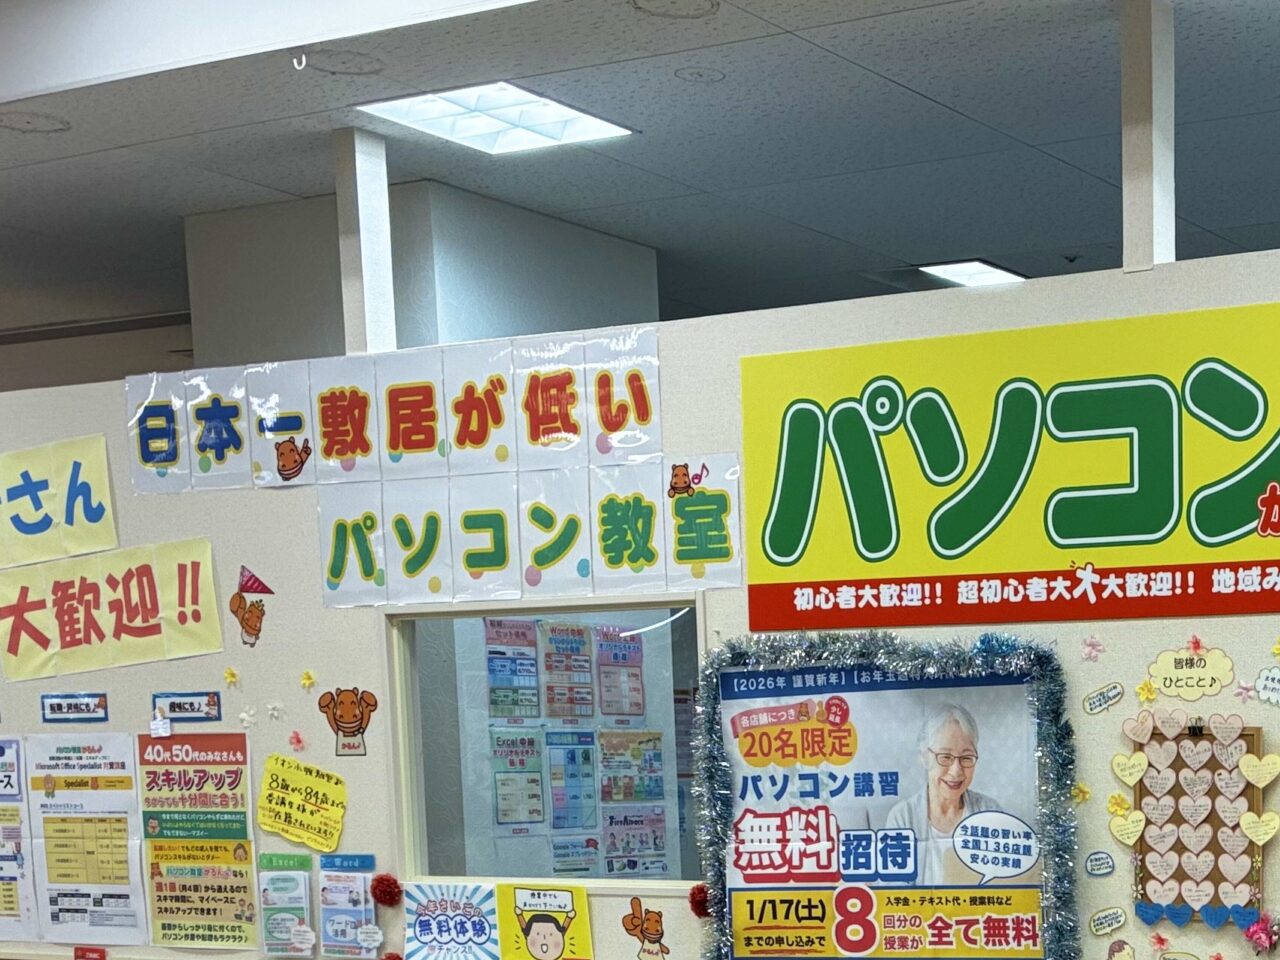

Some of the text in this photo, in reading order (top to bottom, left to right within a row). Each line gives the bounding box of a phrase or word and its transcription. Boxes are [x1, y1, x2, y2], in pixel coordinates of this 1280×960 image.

[136, 368, 653, 468] 日本一敷居が低い
[5, 459, 107, 536] さん
[327, 488, 734, 586] パソコン教室
[0, 560, 203, 658] 大歓迎!!
[793, 581, 943, 612] 初心者大歓迎!!
[1173, 657, 1207, 669] 皆様の
[1163, 676, 1208, 688] ひとこと
[740, 708, 796, 729] 各店舗につき
[144, 744, 244, 763] 40代50代のみなさんも
[743, 727, 853, 760] 20名限定
[145, 767, 243, 791] スキルアップ
[739, 771, 900, 801] パソコン講習
[735, 804, 840, 875] 無料
[959, 823, 1033, 842] 今話題の習い事
[841, 831, 916, 872] 招待
[745, 898, 826, 924] 1/17(土)
[834, 887, 877, 953] 8
[883, 913, 923, 931] 回分の
[418, 917, 489, 939] 無料体験
[744, 935, 826, 948] までの申し込みで
[926, 914, 1041, 949] 全て無料
[883, 935, 924, 951] 授業が
